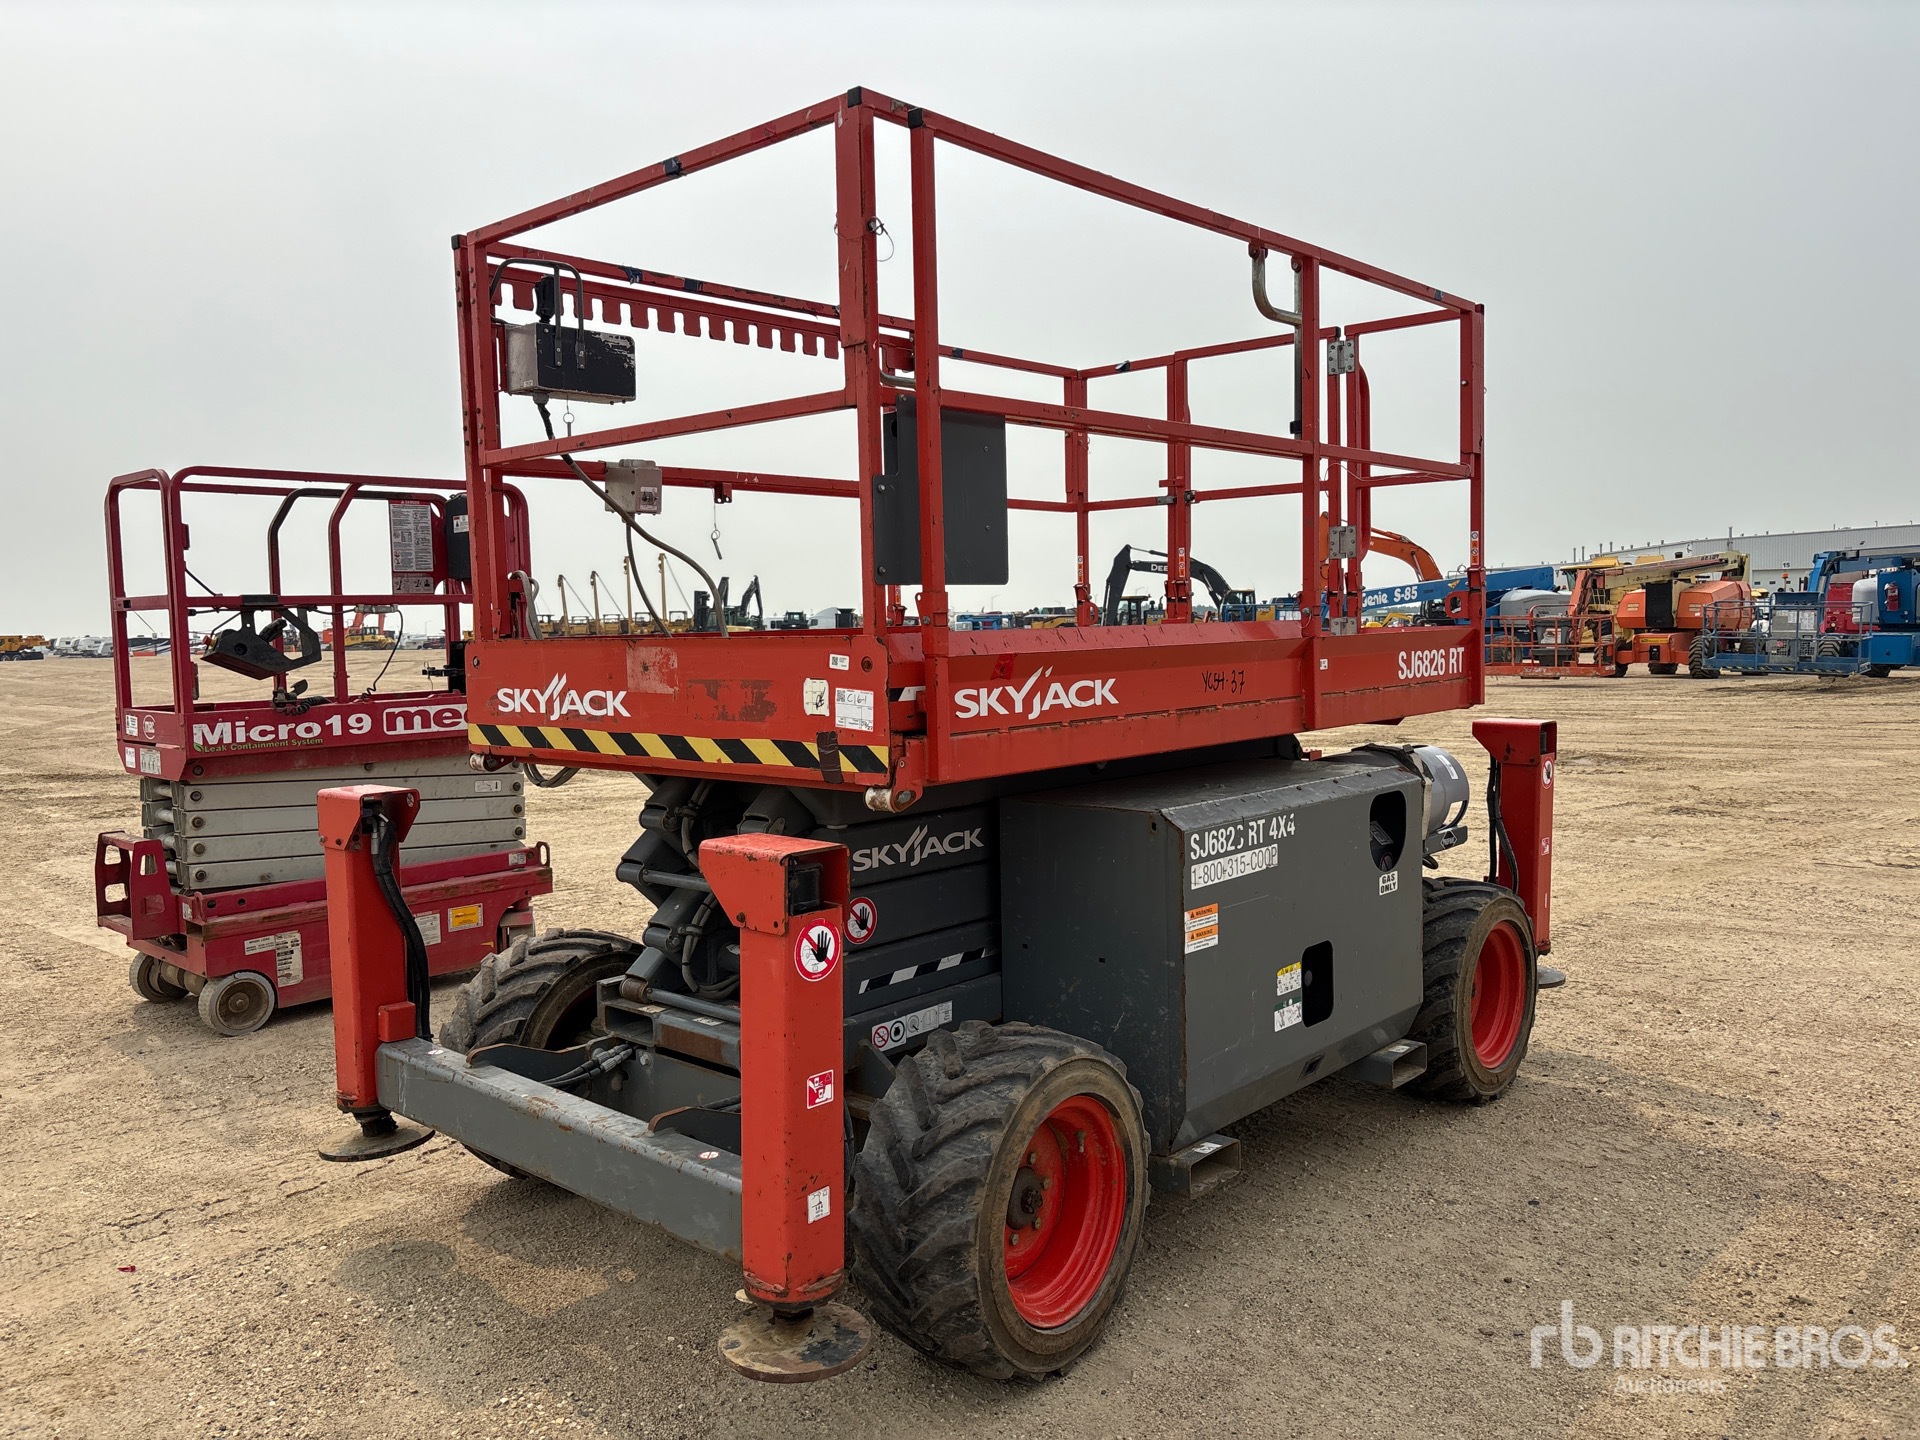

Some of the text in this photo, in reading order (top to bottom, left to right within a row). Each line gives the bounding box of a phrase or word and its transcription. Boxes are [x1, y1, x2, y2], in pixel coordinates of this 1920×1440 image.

[1393, 586, 1418, 602] S-85
[1397, 646, 1465, 680] SJ6826 RT
[496, 672, 632, 721] SKYJACK
[954, 665, 1119, 720] SKYJACK
[385, 707, 468, 732] me
[204, 737, 323, 752] Leak Containment System
[1248, 819, 1266, 846] RT
[1269, 813, 1296, 840] 4X4
[852, 824, 985, 872] SKYJACK
[1380, 882, 1397, 893] ONLY
[1382, 873, 1395, 884] GAS
